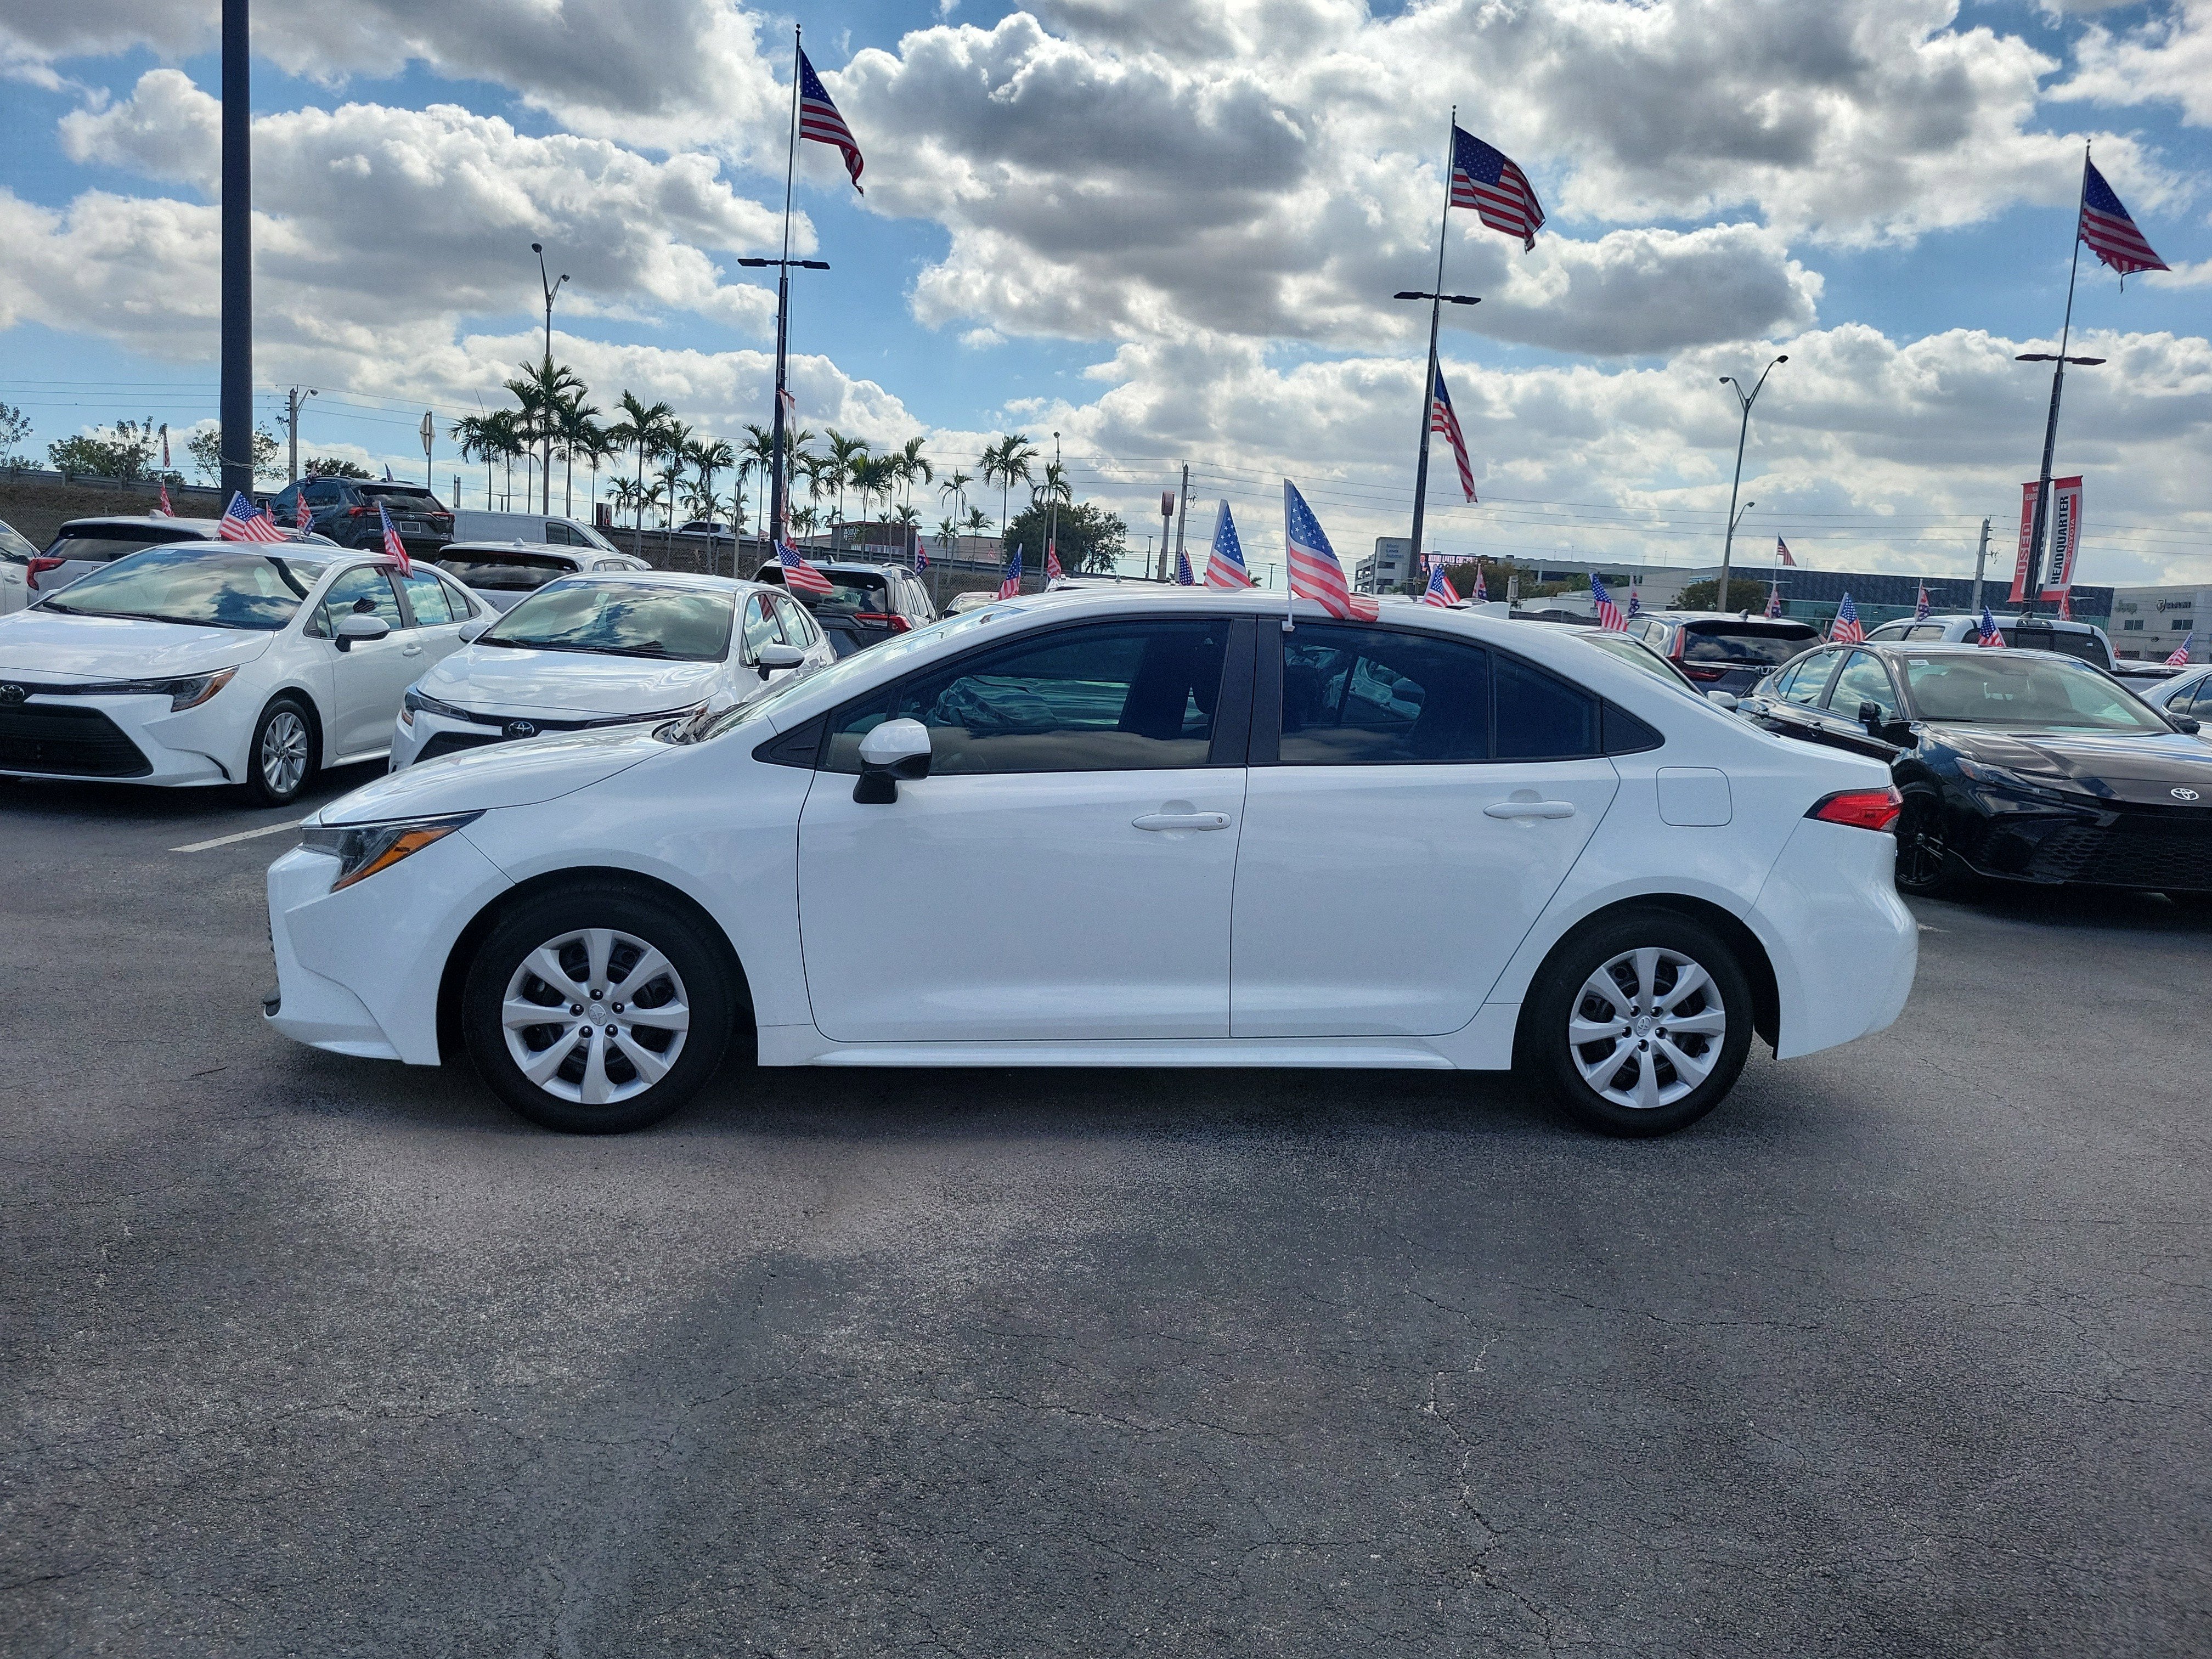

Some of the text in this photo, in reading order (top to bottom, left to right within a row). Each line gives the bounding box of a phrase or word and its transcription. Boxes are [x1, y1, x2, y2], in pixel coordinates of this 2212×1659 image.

[2016, 523, 2032, 575] USED
[2050, 495, 2069, 585] HEADQUARTER
[2067, 518, 2075, 554] TOYOTA
